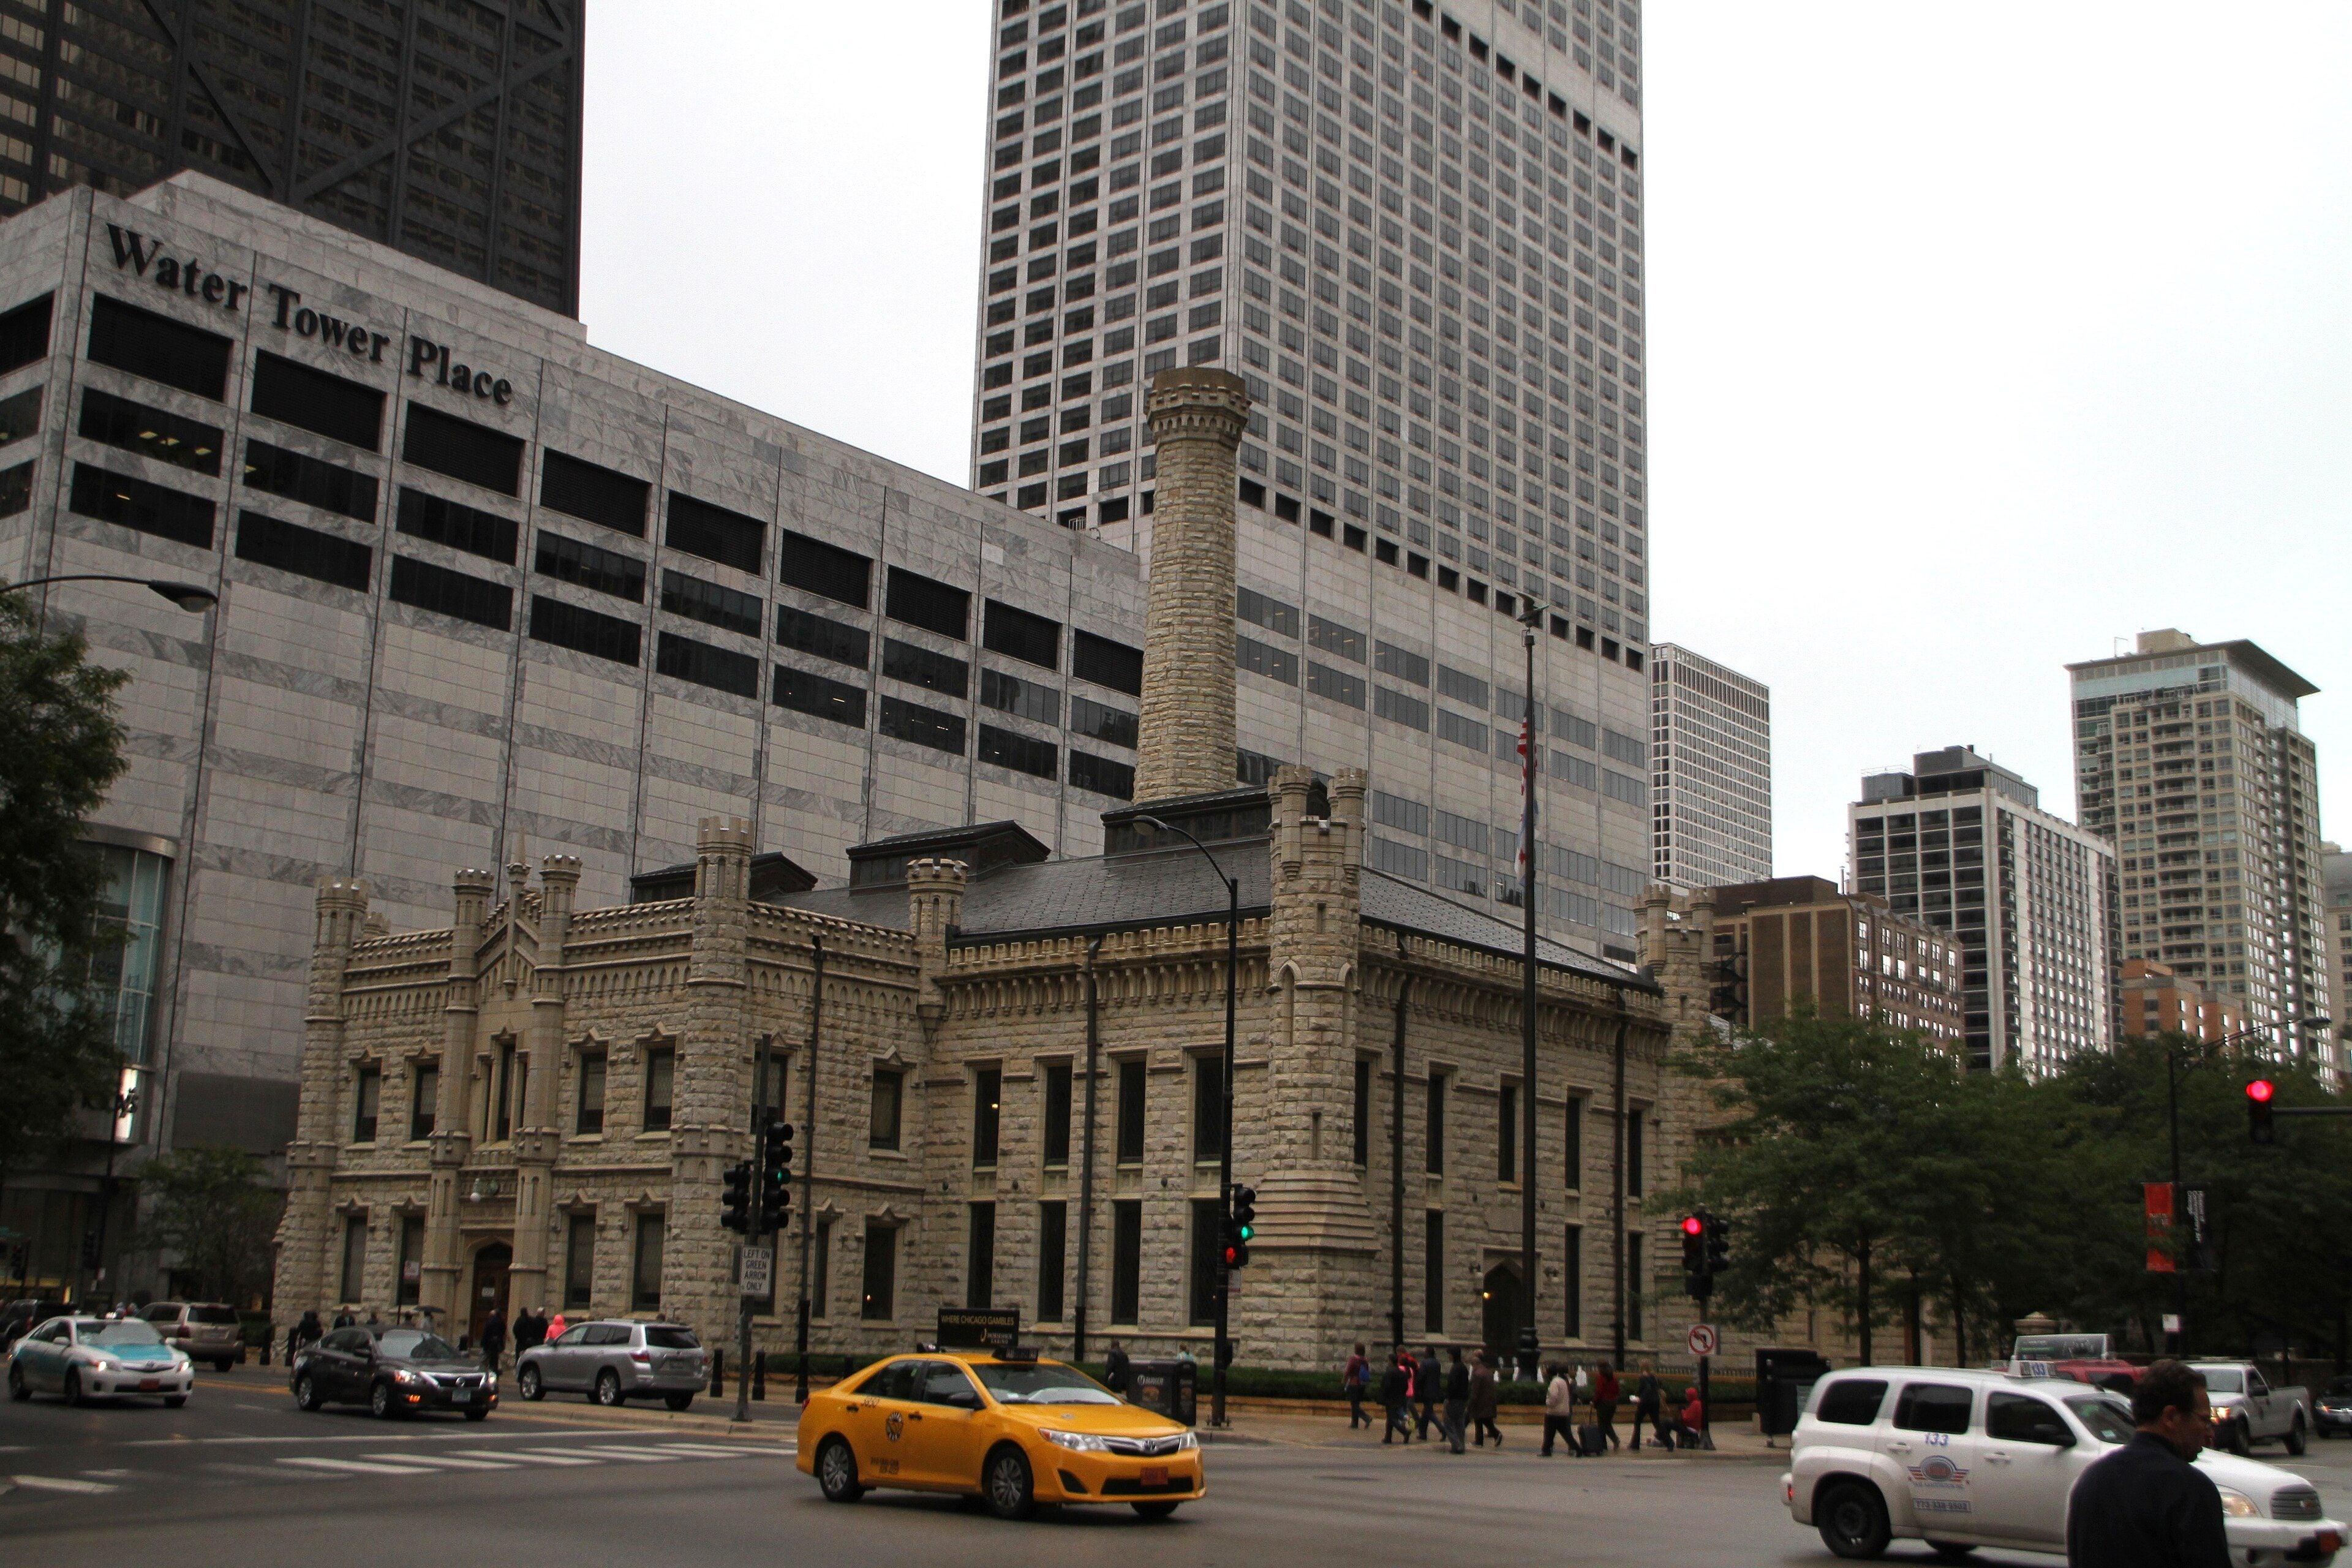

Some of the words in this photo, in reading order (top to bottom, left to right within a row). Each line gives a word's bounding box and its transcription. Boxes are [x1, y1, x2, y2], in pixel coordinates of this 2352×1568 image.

[107, 222, 248, 311] Water
[268, 283, 391, 363] Tower
[407, 334, 513, 405] Place
[744, 1249, 759, 1259] LEFT
[761, 1250, 770, 1259] ON
[746, 1259, 767, 1270] GREEN
[744, 1270, 766, 1280] ARROW
[747, 1281, 763, 1291] ONLY
[960, 1315, 987, 1324] CHICAGO
[987, 1316, 1014, 1325] GAMBLES
[2032, 1362, 2046, 1376] 133
[1924, 1432, 1949, 1446] 133
